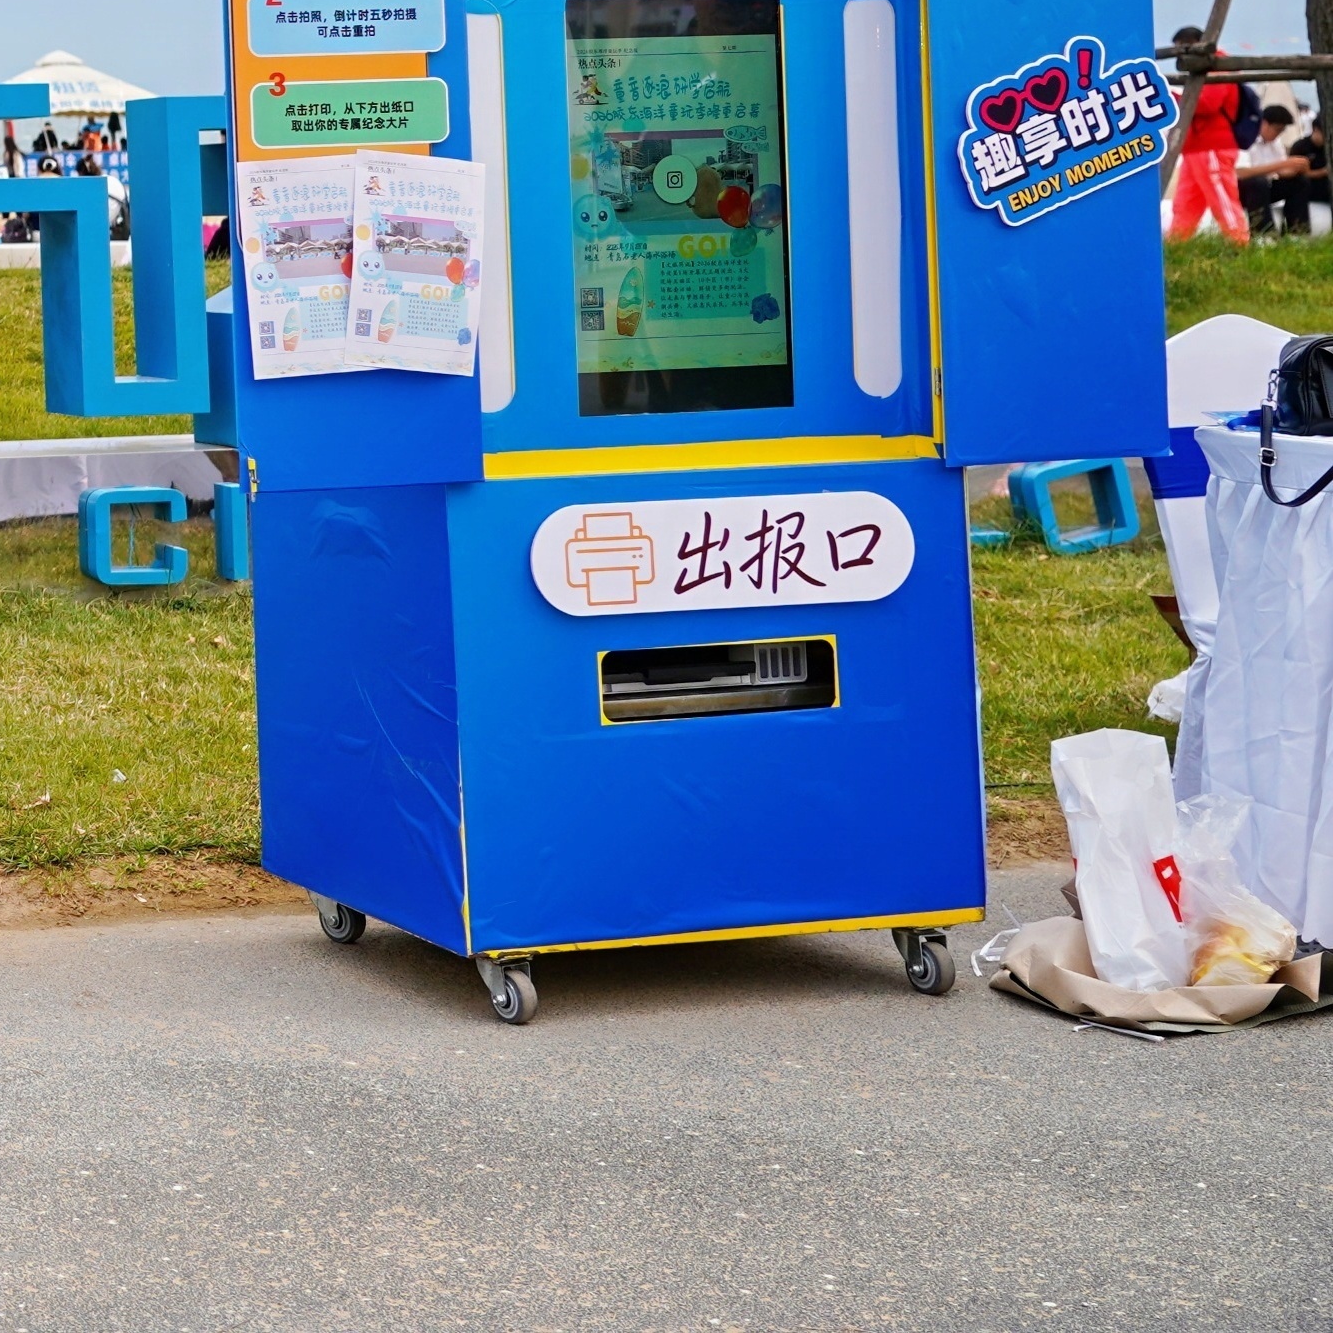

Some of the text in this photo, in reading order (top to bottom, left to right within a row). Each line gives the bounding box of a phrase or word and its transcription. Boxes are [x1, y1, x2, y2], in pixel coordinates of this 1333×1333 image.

[275, 8, 417, 24] 点击拍照，倒计时五秒拍摄
[317, 25, 376, 38] 可点击重拍
[269, 72, 286, 96] 3
[284, 100, 415, 117] 点击打印，从下方出纸口
[290, 117, 409, 133] 取出你的专属纪念大片
[970, 71, 1165, 192] 趣享时光
[1007, 133, 1156, 213] ENJOY MOMENTS
[673, 508, 882, 595] 出报口
